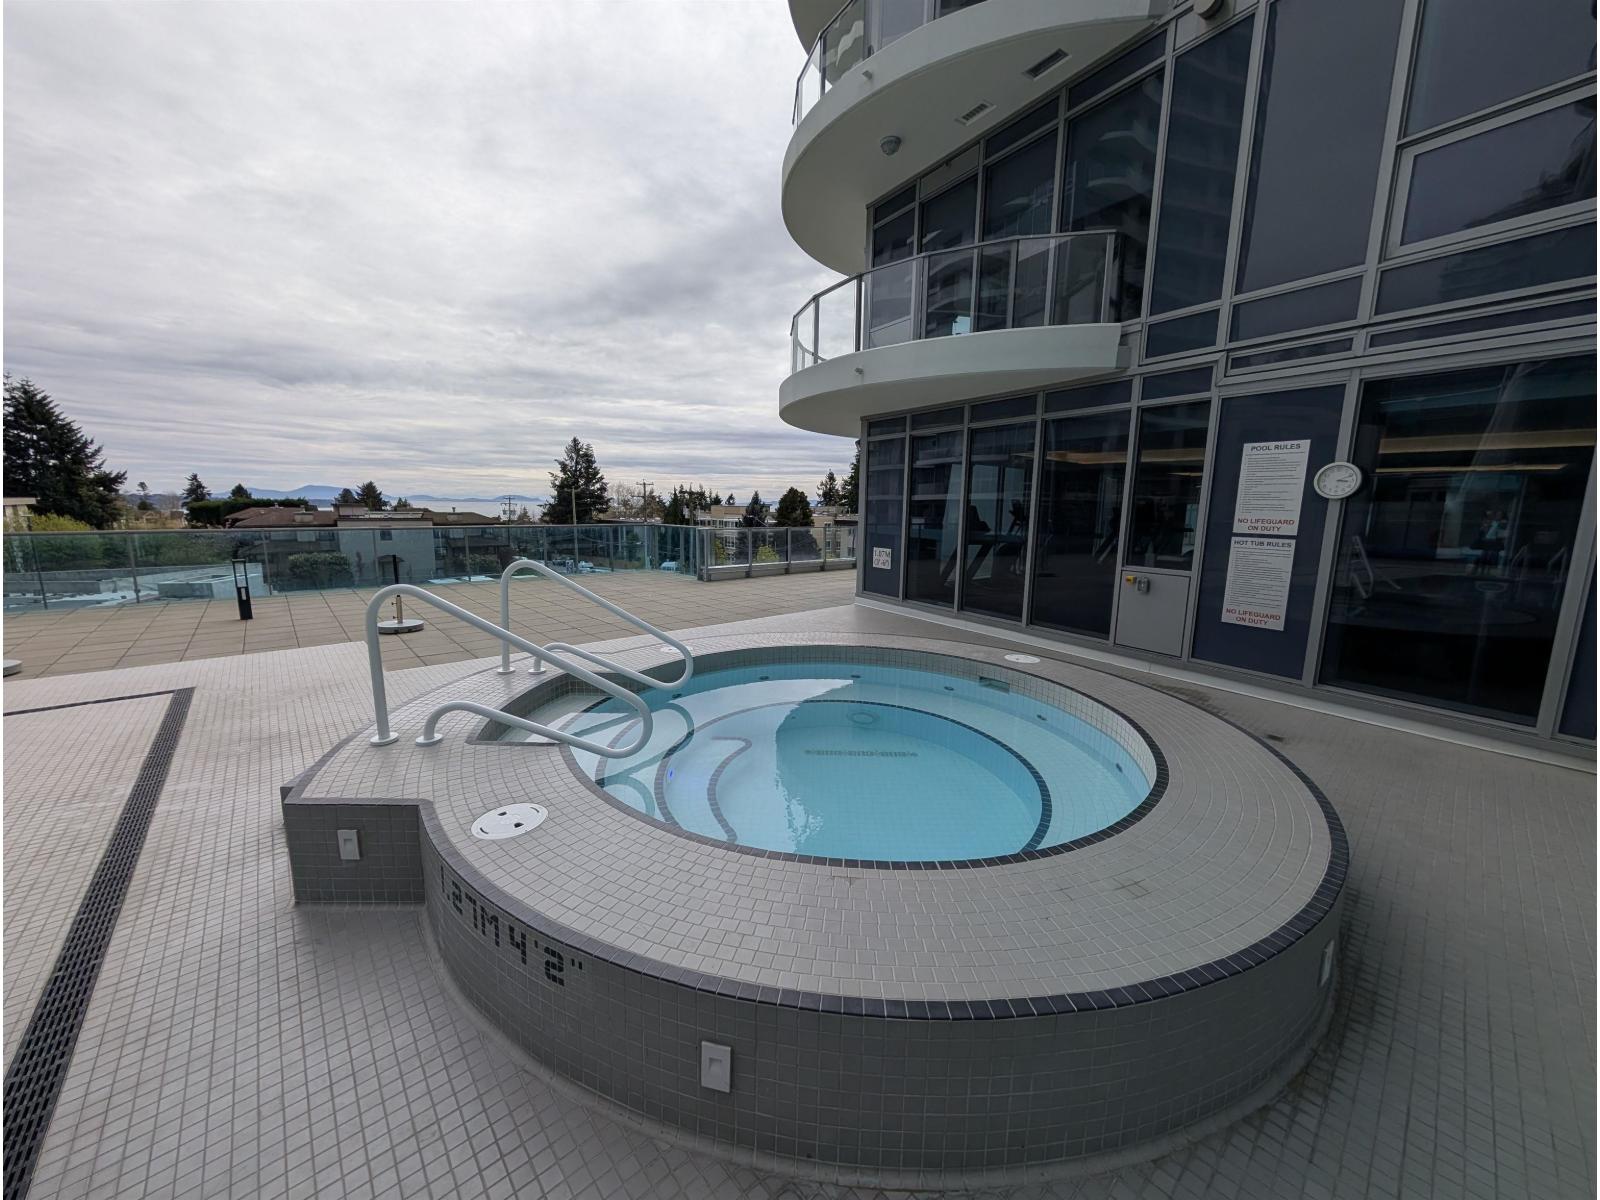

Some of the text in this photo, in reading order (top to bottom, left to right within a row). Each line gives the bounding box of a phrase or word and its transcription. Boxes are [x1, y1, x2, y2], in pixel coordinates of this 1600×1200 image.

[1274, 443, 1301, 451] RULES
[1238, 609, 1281, 621] LIFEGUARD
[1248, 617, 1268, 625] DUTY
[440, 865, 500, 947] 1.27M
